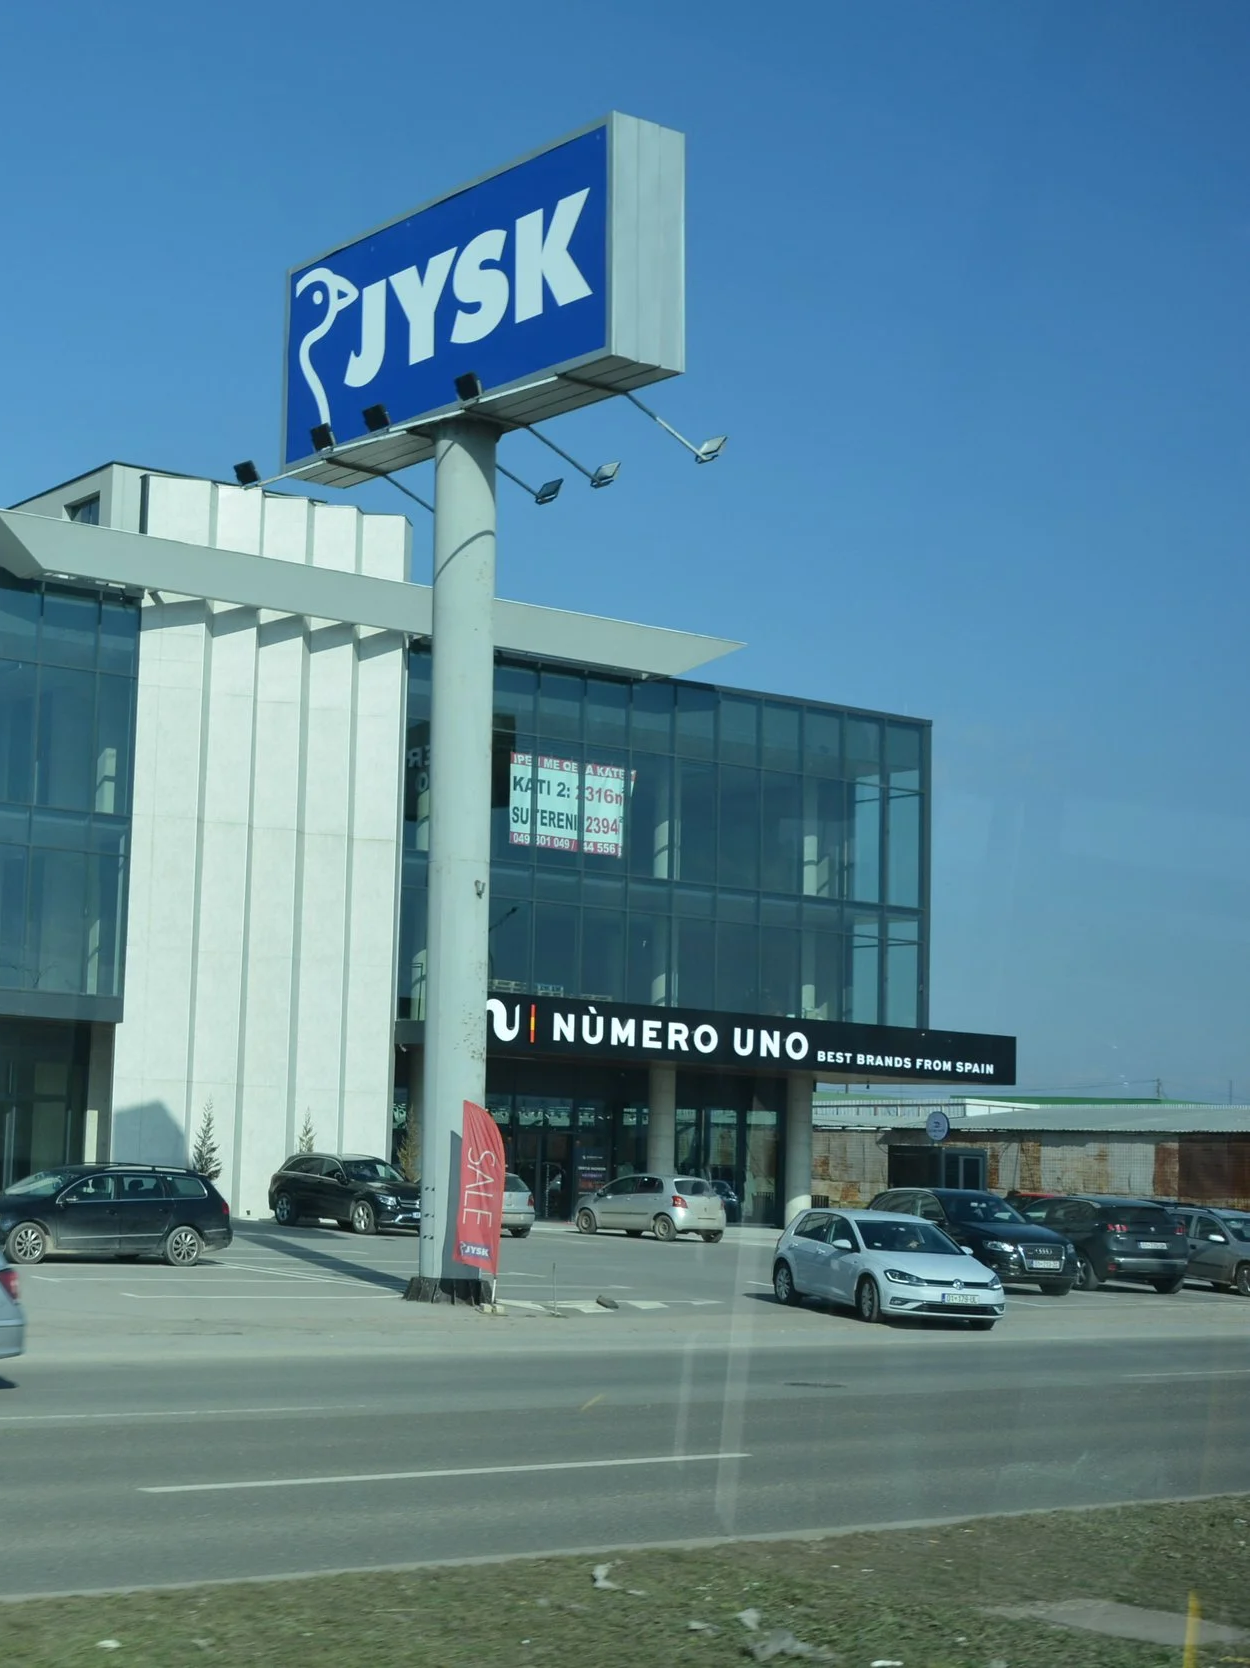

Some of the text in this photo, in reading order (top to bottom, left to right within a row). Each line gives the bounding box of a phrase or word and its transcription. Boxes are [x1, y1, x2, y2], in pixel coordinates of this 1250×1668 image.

[343, 187, 594, 388] JYSK
[543, 758, 560, 770] ME
[562, 761, 594, 775] QEA
[513, 775, 551, 796] KATI
[556, 781, 571, 798] 2:
[512, 805, 578, 831] SUERENI
[513, 832, 530, 845] 049
[553, 837, 570, 849] 049
[597, 842, 616, 854] 556
[733, 1027, 810, 1061] UNO
[817, 1050, 995, 1075] BEST BRANDS FROM SPAIN
[462, 1147, 496, 1228] SALE
[465, 1245, 489, 1257] JYSK
